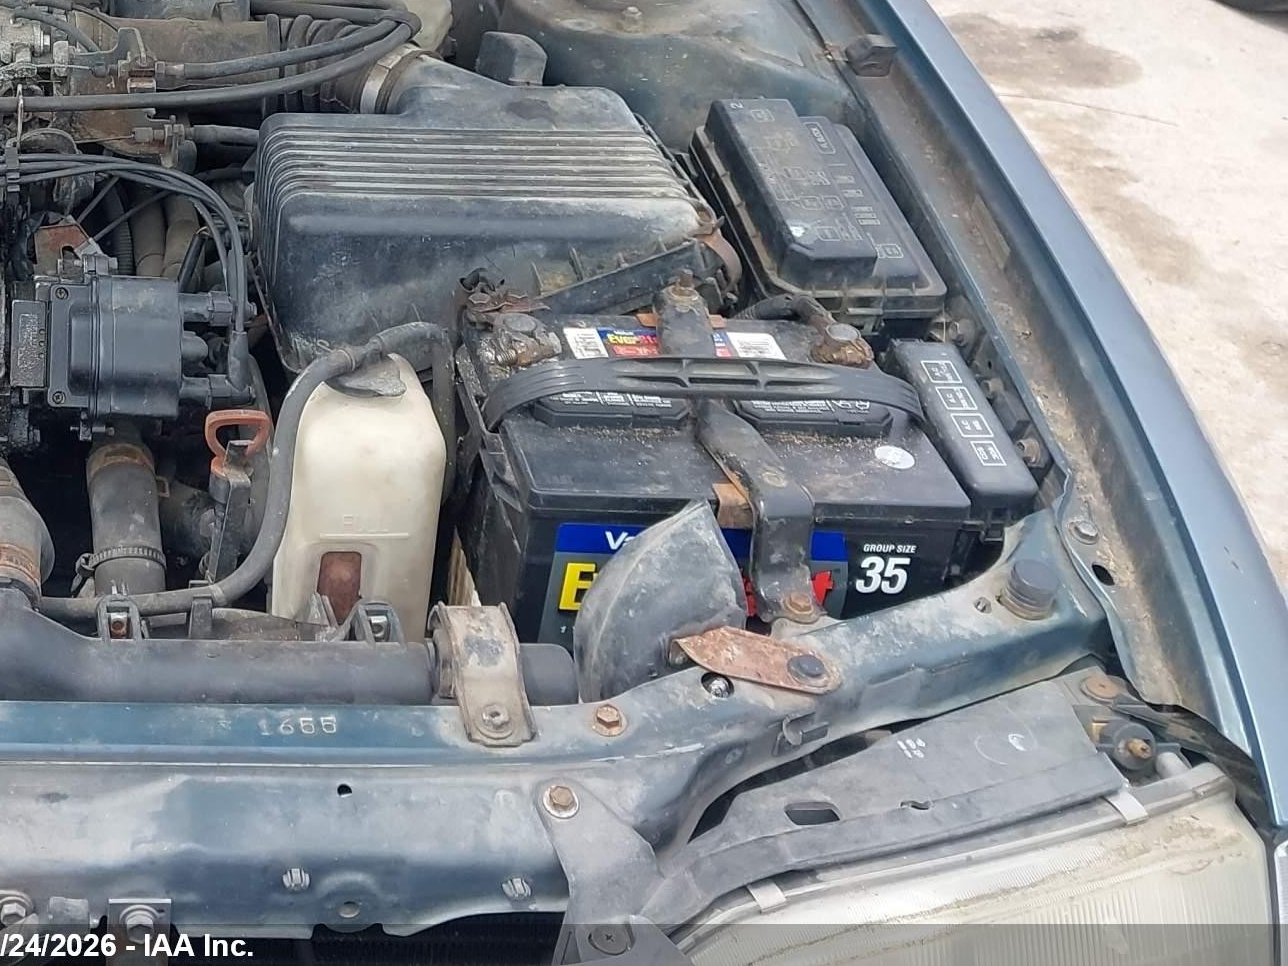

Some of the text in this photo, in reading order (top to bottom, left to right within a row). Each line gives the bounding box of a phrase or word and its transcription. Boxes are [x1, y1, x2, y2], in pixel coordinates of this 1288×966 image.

[863, 543, 917, 553] GROUP SIZE
[855, 555, 911, 594] 35
